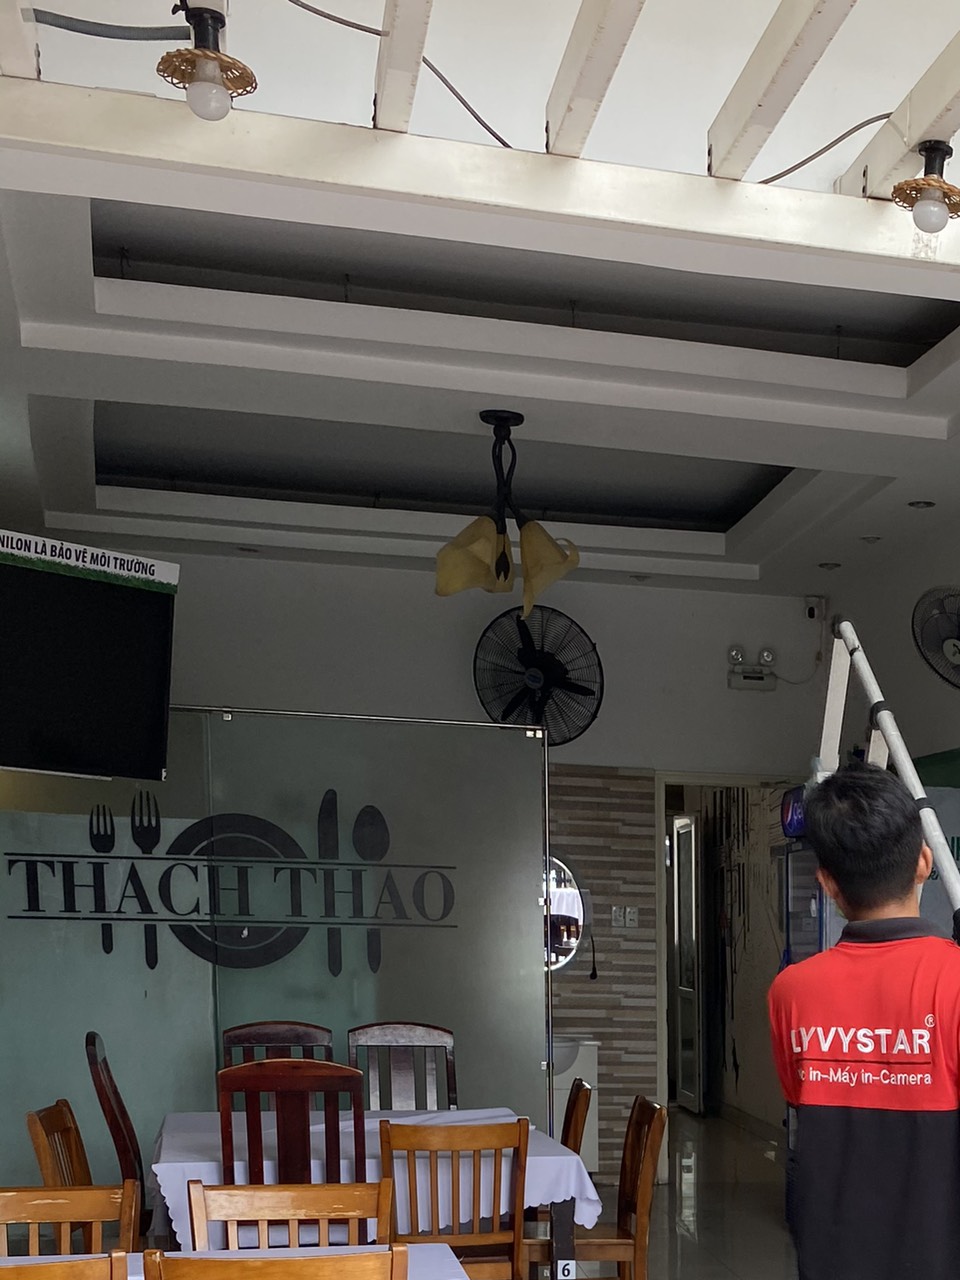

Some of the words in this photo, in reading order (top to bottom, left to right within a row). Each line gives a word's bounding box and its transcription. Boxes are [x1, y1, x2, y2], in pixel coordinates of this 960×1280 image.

[34, 540, 47, 556] LÀ
[50, 542, 72, 560] BẢO
[89, 552, 110, 568] MÔI
[113, 556, 155, 576] TRƯỜNG
[8, 859, 255, 917] THACH
[274, 866, 456, 922] THAO
[790, 1026, 931, 1054] LYVYSTAR
[861, 1068, 932, 1085] in-Camera
[562, 1263, 570, 1277] 6
